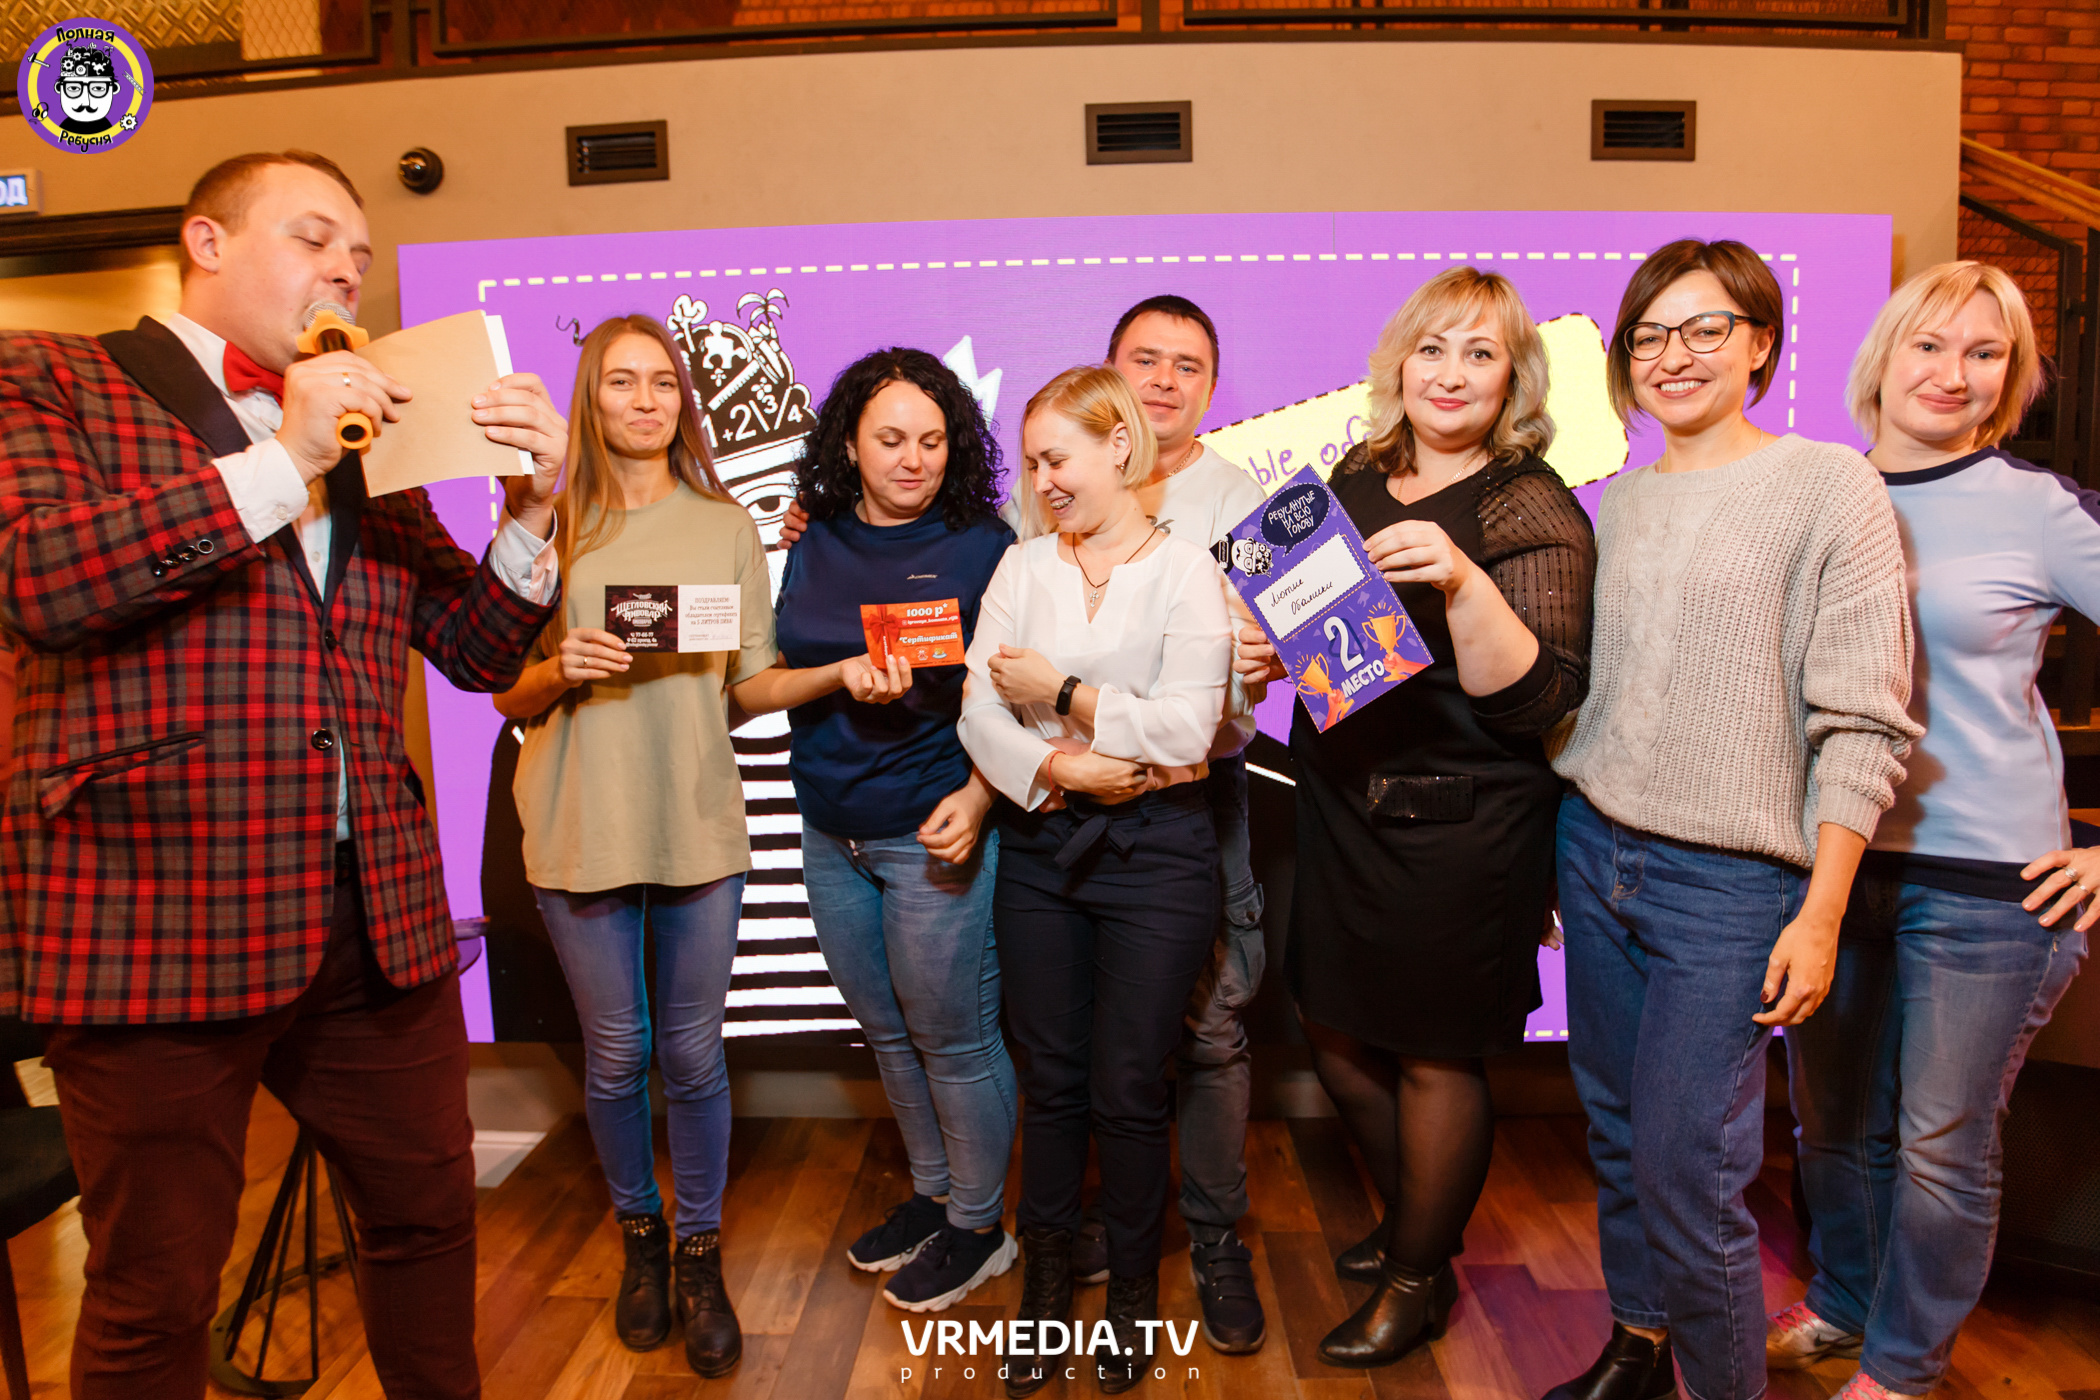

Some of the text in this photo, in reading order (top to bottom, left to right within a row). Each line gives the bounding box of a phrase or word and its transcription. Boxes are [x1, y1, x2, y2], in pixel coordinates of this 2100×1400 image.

[1293, 505, 1312, 522] ВСЮ
[1287, 514, 1315, 538] ГОЛОВУ
[906, 607, 933, 617] 1000
[899, 631, 958, 645] Сертификат
[1323, 615, 1365, 673] 2
[1340, 659, 1385, 699] МЕСТО
